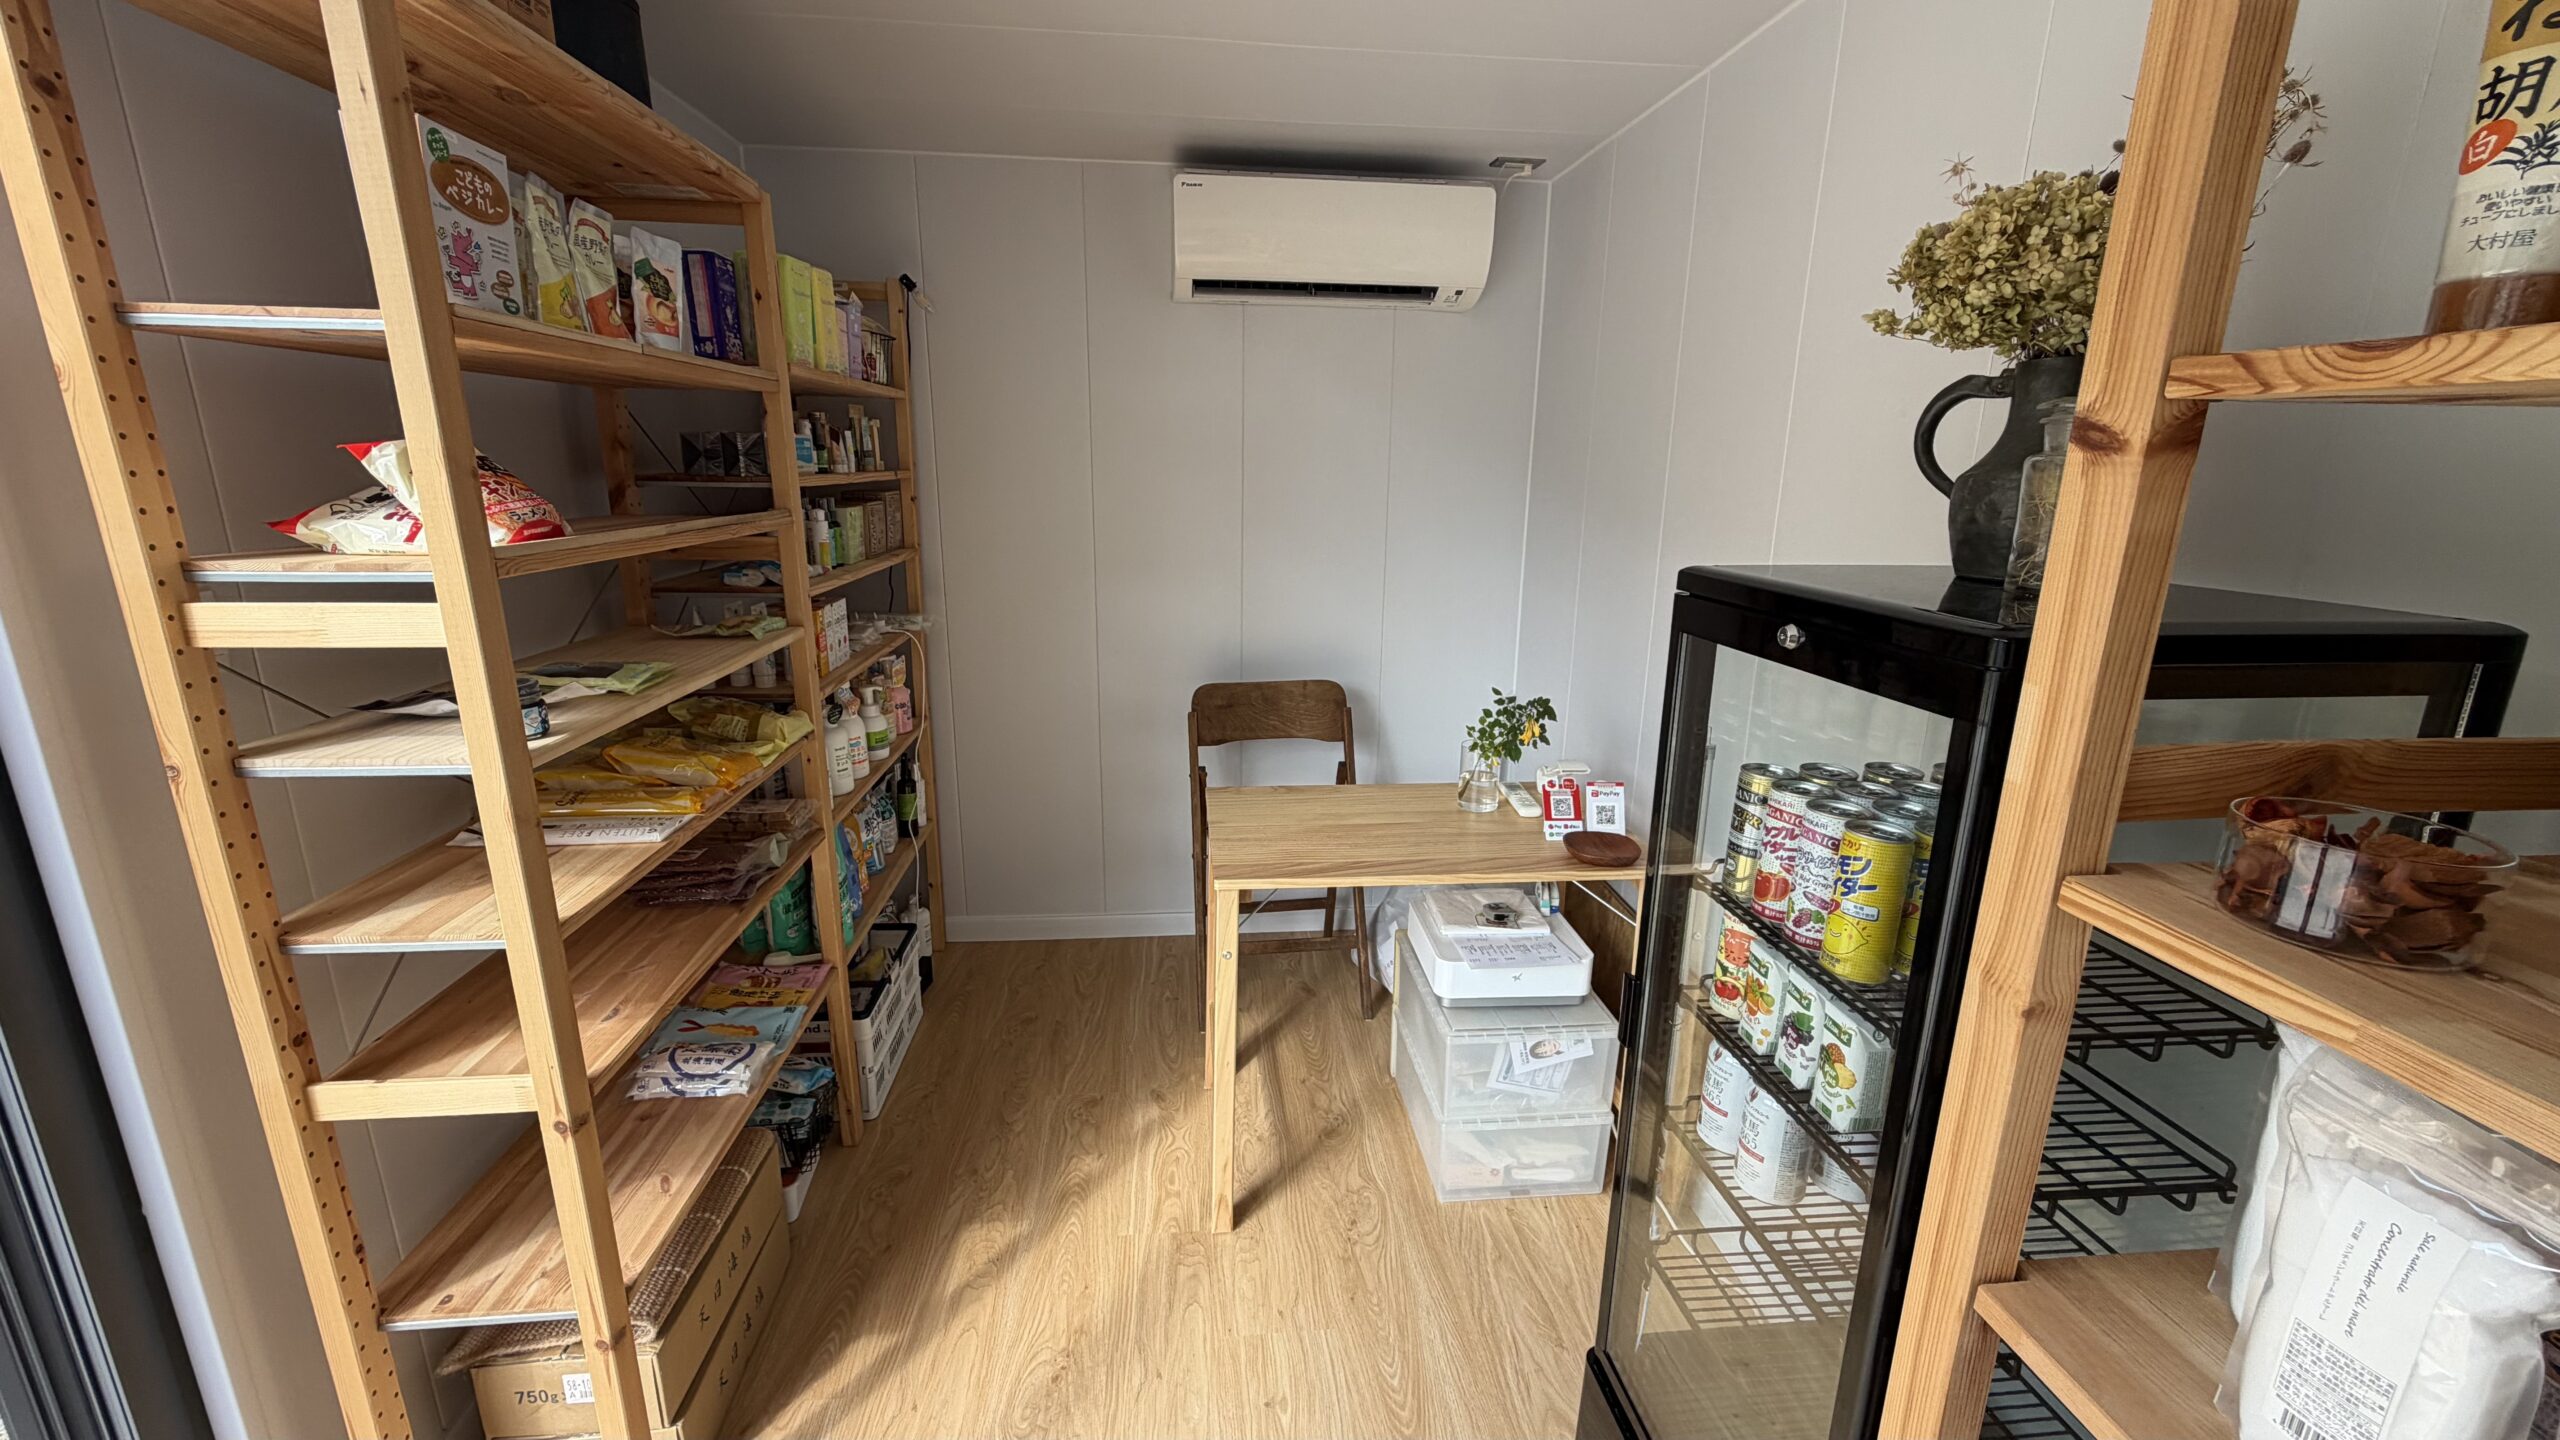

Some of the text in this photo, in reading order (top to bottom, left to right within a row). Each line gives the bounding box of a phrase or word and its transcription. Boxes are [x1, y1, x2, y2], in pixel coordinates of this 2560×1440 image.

[2475, 54, 2560, 125] 胡
[2467, 129, 2499, 165] 白
[454, 167, 493, 197] こどもの
[445, 184, 504, 214] ベジカレー
[2465, 228, 2538, 254] 大村屋
[508, 507, 547, 521] ラーメン
[2396, 1231, 2436, 1293] Sale naturale
[2344, 1222, 2402, 1338] Concentrato del mare
[514, 1389, 560, 1405] 750g
